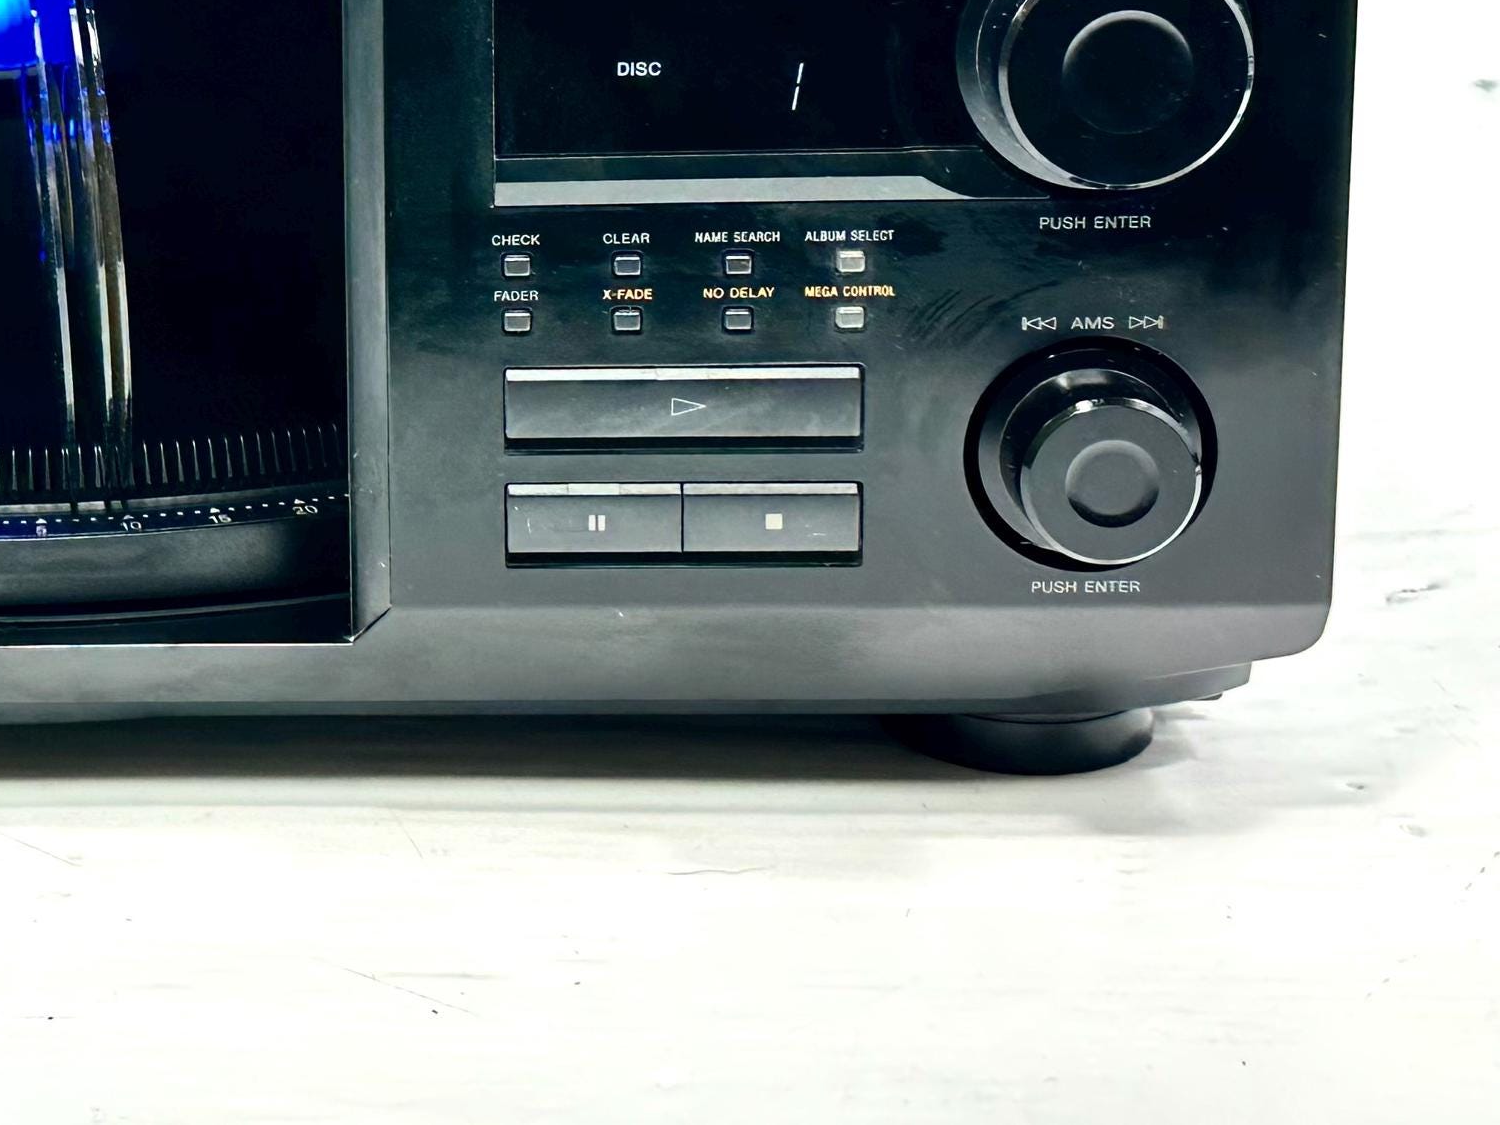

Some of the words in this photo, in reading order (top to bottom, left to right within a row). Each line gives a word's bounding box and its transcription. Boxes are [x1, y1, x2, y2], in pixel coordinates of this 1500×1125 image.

[616, 61, 662, 77] DISC
[1039, 216, 1087, 230] PUSH
[1093, 215, 1152, 230] ENTER
[491, 233, 541, 248] CHECK
[602, 231, 651, 246] CLEAR
[694, 230, 731, 244] NAME
[734, 230, 781, 243] SEARCH
[804, 229, 846, 243] ALBUM
[848, 228, 895, 243] SELECT
[493, 289, 540, 304] FADER
[602, 287, 653, 301] X-FADE
[703, 286, 724, 301] NO
[728, 286, 775, 301] DELAY
[804, 285, 838, 298] MEGA
[841, 284, 896, 298] CONTROL
[1071, 316, 1115, 331] AMS
[295, 505, 318, 516] 20
[120, 520, 142, 531] 10
[210, 513, 232, 524] 15
[1031, 580, 1079, 594] PUSH
[1084, 579, 1141, 594] ENTER
